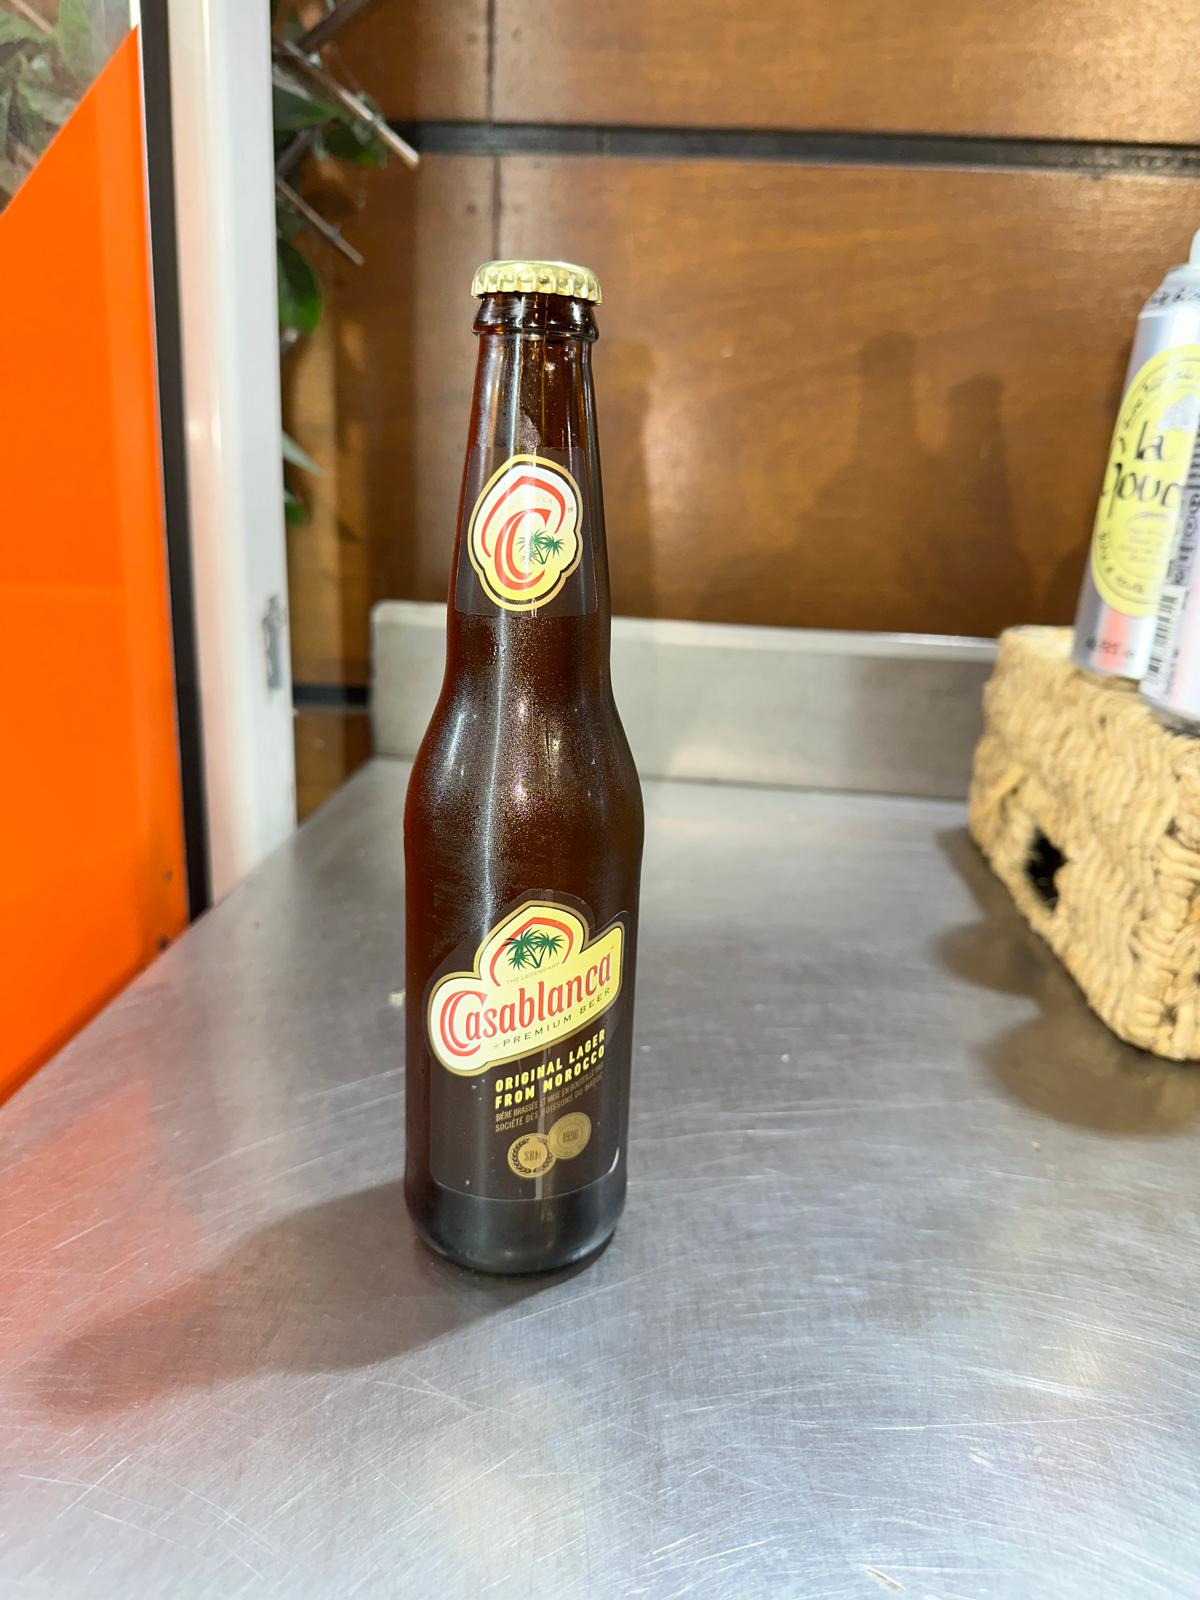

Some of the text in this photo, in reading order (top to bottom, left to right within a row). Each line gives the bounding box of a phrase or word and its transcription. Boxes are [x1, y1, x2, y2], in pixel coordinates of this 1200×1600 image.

[439, 953, 611, 1057] Casablanca
[503, 987, 611, 1048] PREMIUM BEER
[495, 1028, 606, 1093] ORIGINAL LAGER
[495, 1045, 605, 1110] FROM MOROCCO
[495, 1108, 513, 1122] BIÈRE
[513, 1099, 539, 1115] BRASSÉE
[495, 1116, 524, 1133] SOCIÉTÉ
[525, 1111, 539, 1123] DES
